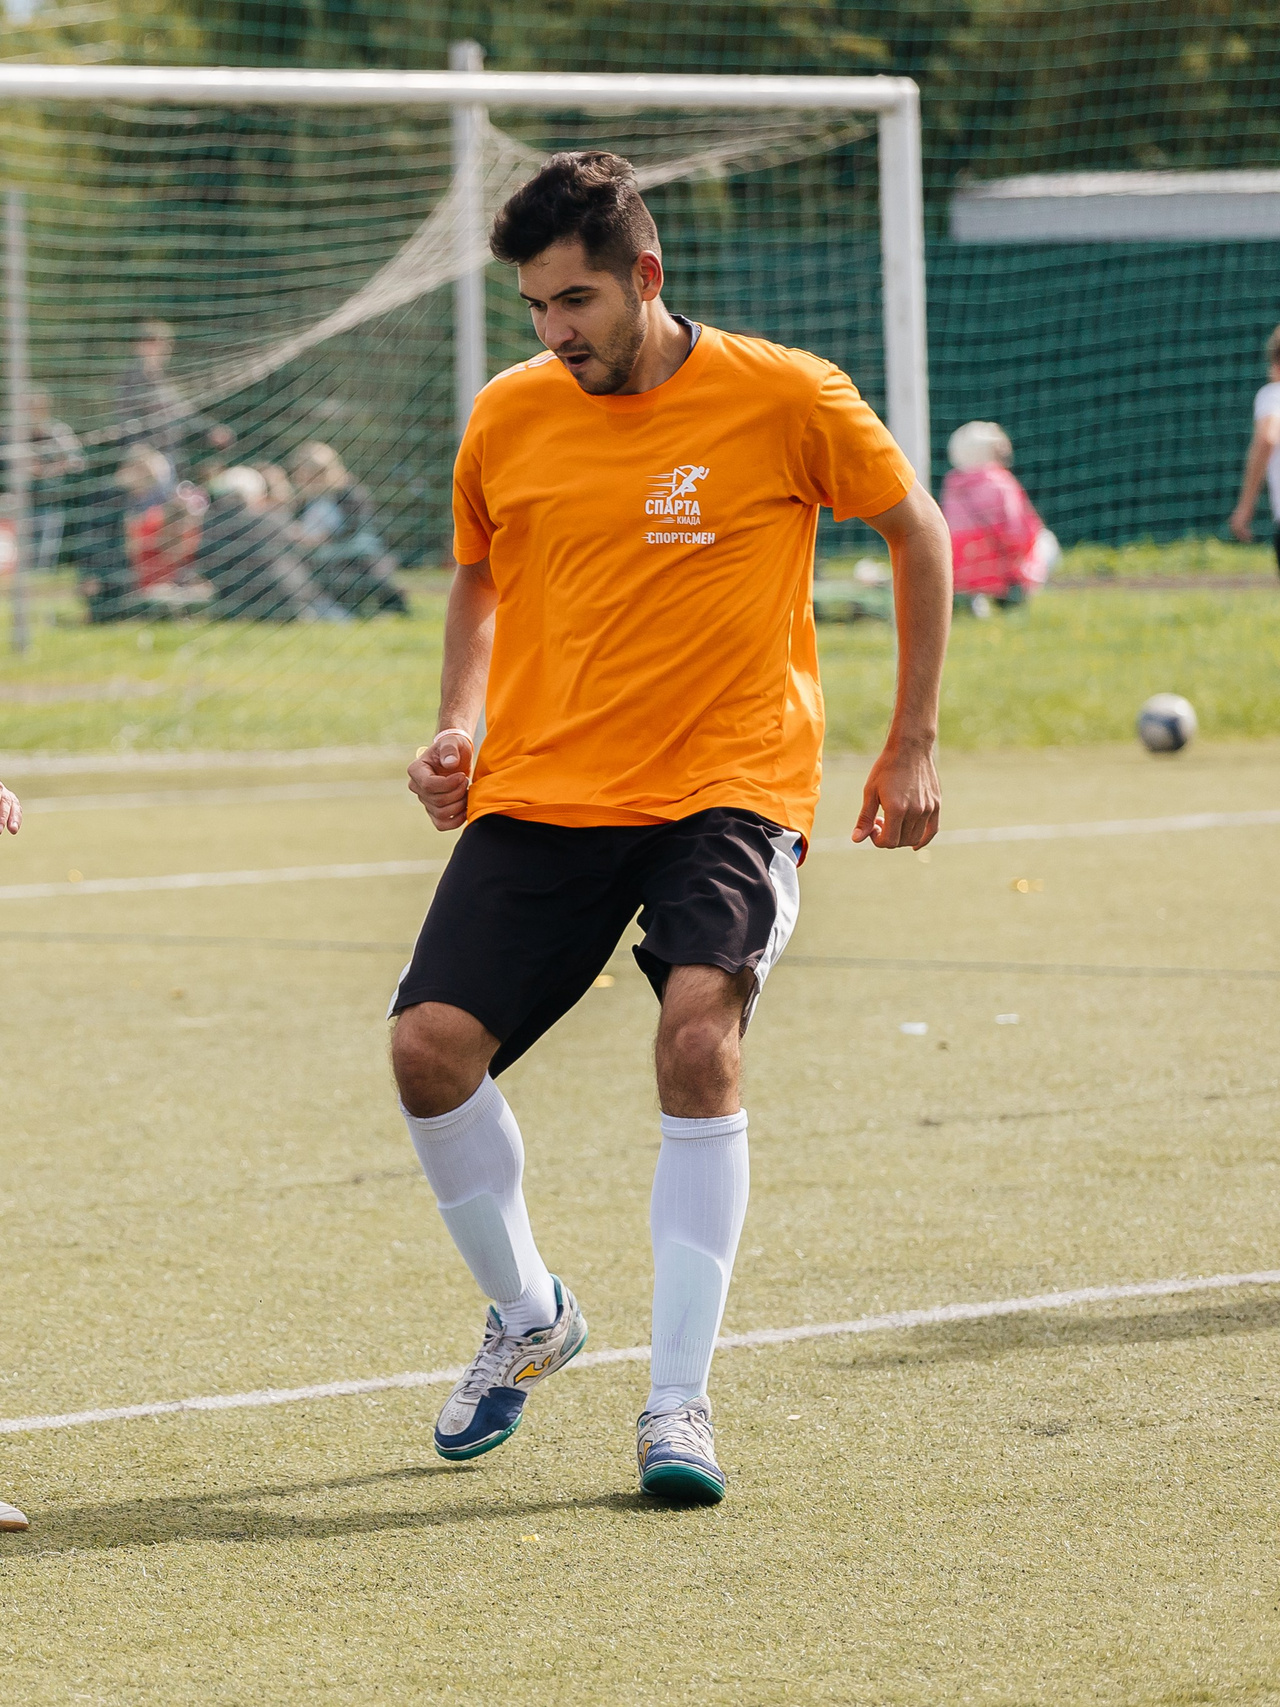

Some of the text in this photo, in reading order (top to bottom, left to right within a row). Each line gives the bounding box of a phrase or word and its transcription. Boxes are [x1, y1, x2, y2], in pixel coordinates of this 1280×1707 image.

[645, 499, 701, 515] СПАРТА
[676, 516, 701, 525] КИАДА
[646, 532, 715, 544] СПОРТСМЕН
